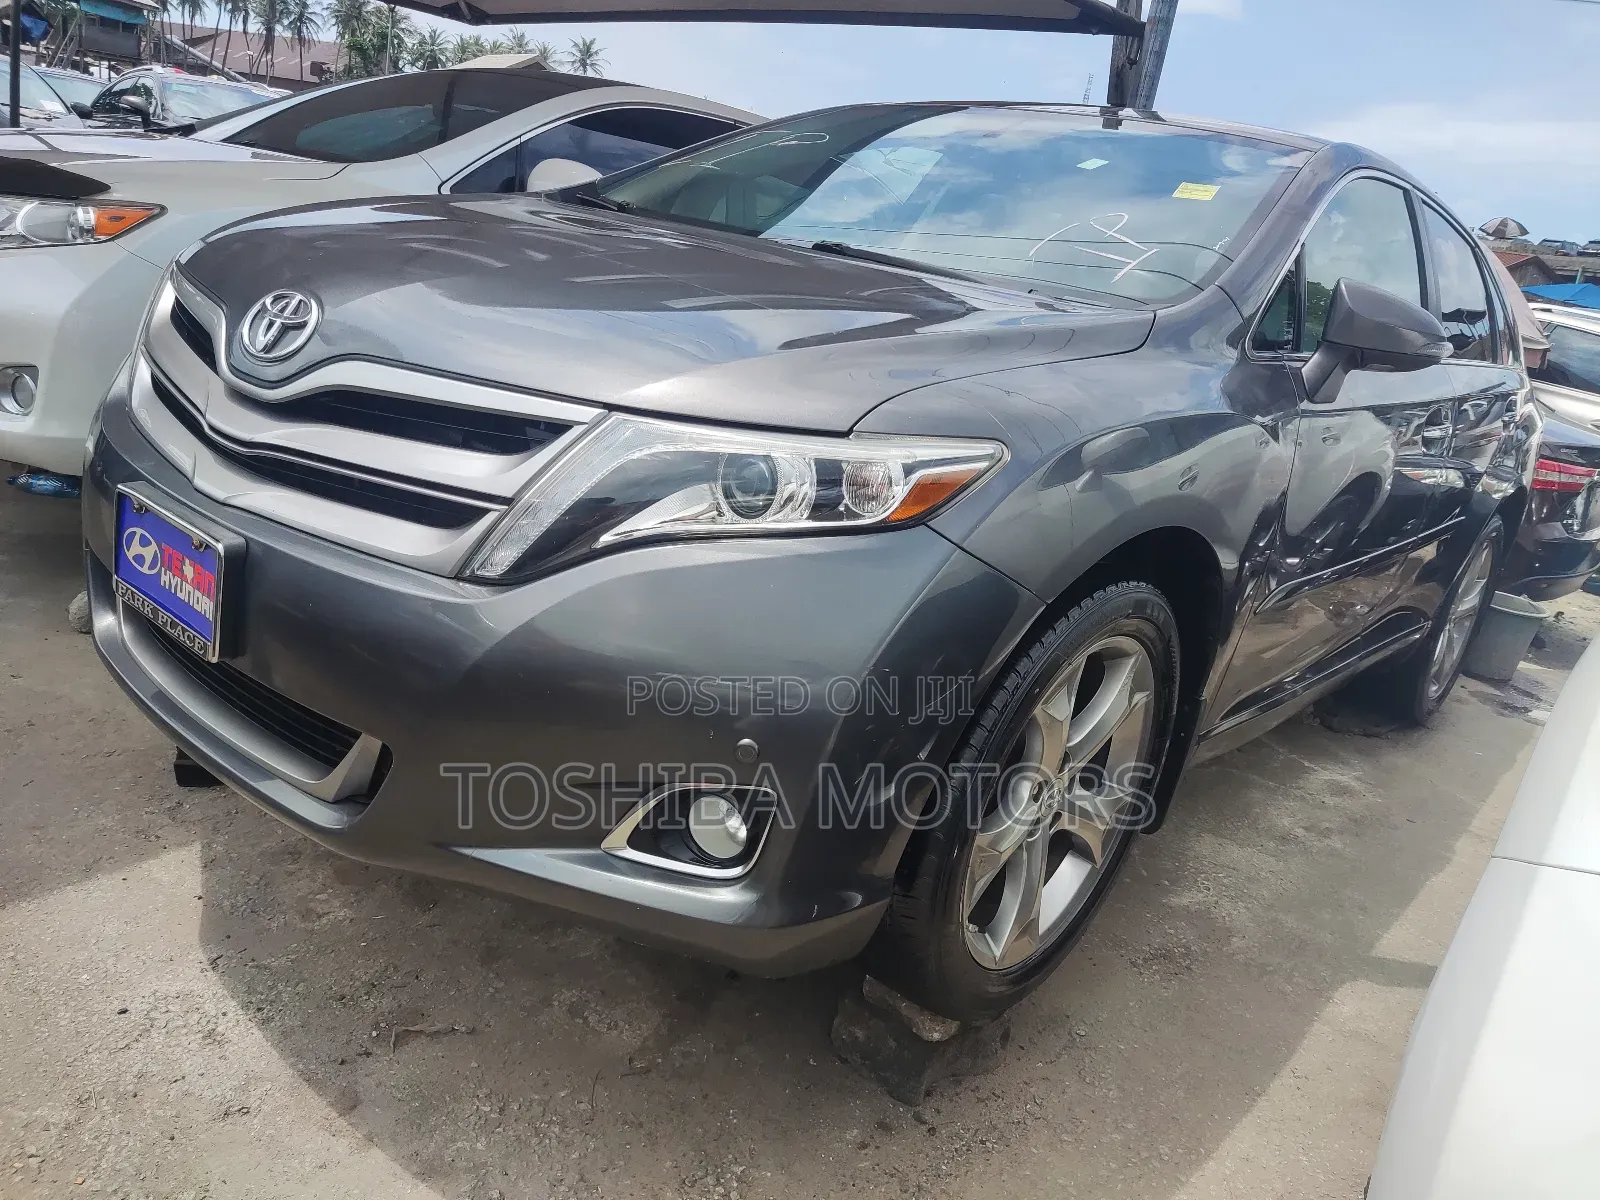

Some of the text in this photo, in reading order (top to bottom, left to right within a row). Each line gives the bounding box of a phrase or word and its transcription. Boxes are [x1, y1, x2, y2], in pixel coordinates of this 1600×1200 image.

[160, 567, 214, 622] HYUNDAI
[162, 543, 215, 601] TEXAN
[118, 584, 205, 655] PARK PLACE
